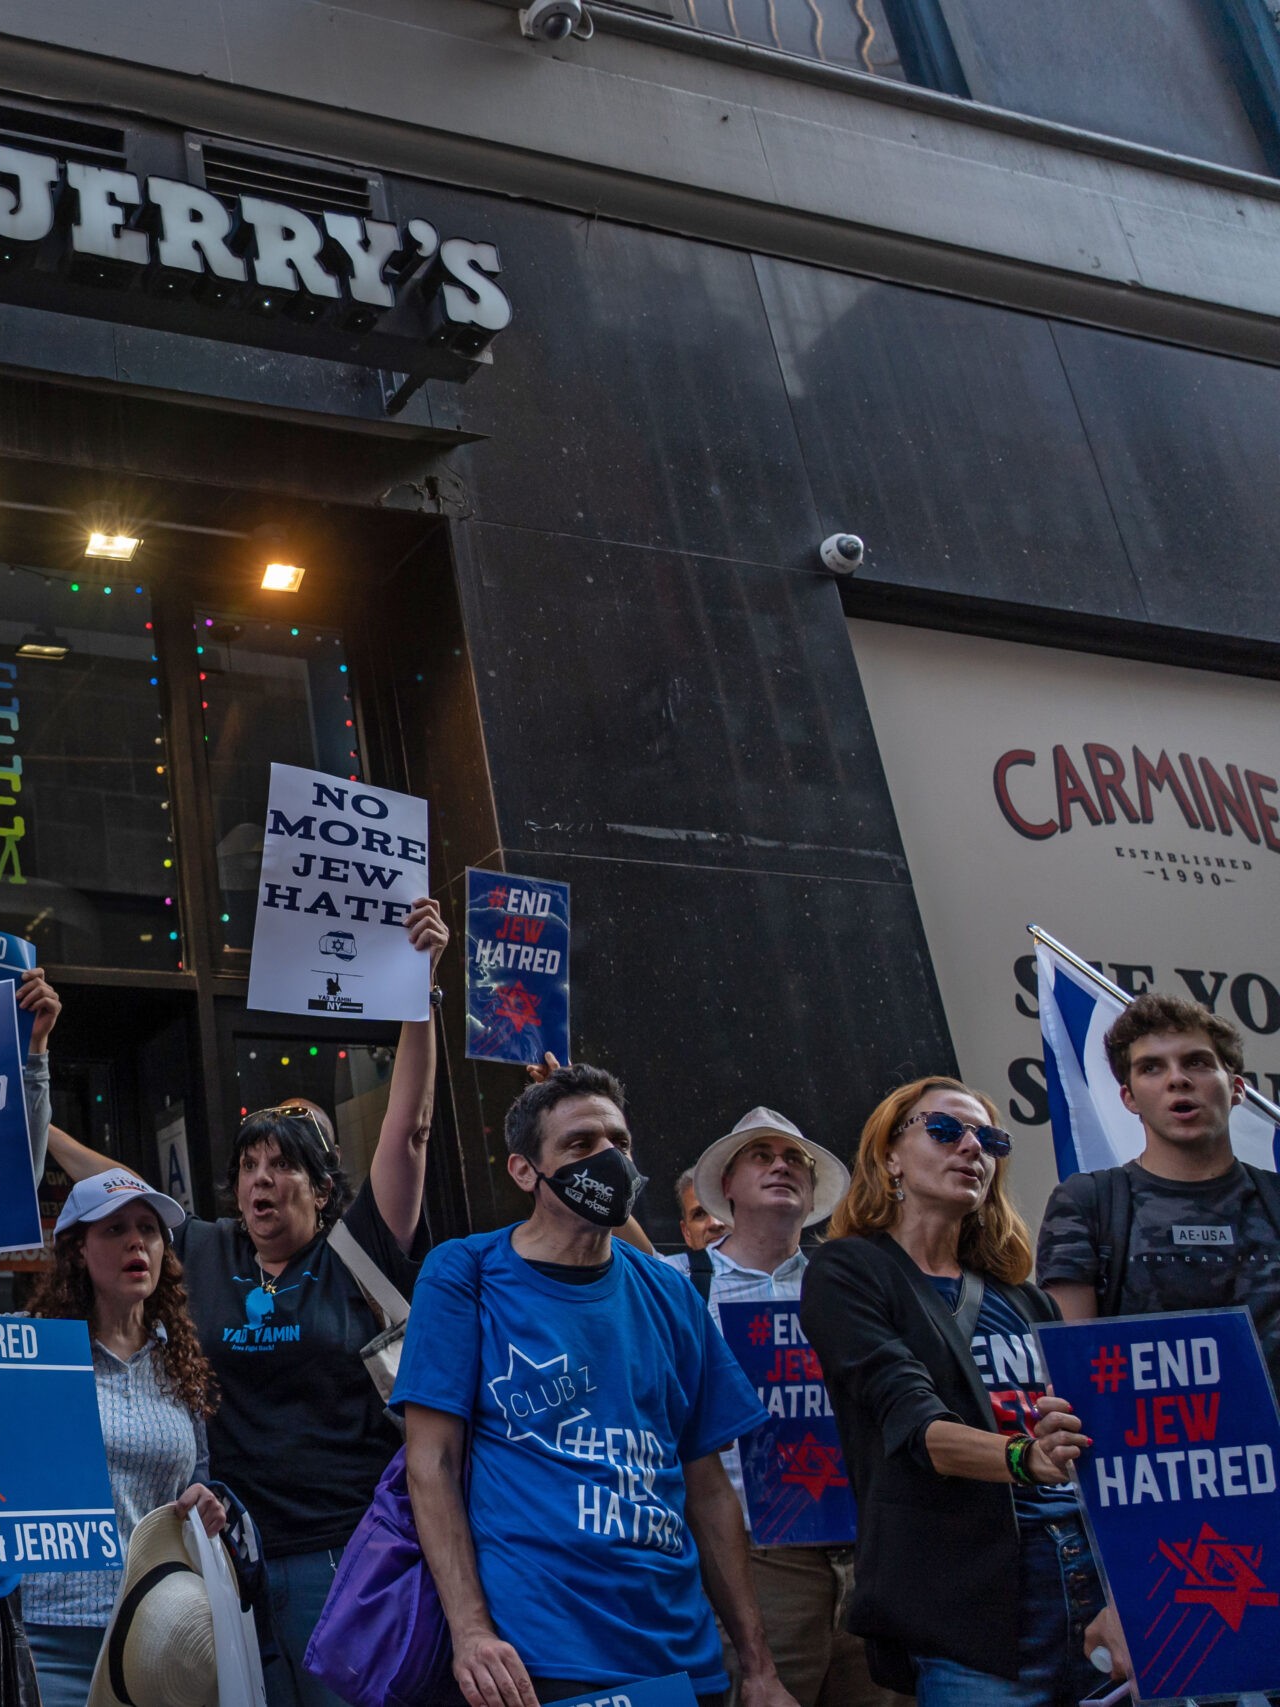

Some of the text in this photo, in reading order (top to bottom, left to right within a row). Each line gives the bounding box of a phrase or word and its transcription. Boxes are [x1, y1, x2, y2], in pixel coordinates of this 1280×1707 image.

[312, 782, 389, 820] NO
[267, 810, 426, 866] MORE
[292, 853, 402, 890] JEW
[1115, 847, 1253, 871] ESTABLISHED
[263, 882, 413, 928] HATE
[487, 886, 552, 916] #END
[496, 916, 545, 943] JEW
[475, 939, 562, 976] HATRED
[327, 1002, 342, 1011] NY
[168, 1143, 186, 1197] A
[221, 1324, 301, 1344] YAD YAMIN
[747, 1312, 809, 1346] #EN
[1090, 1336, 1221, 1394] #END
[510, 1366, 598, 1418] CLUB Z
[1124, 1391, 1220, 1448] JEW
[1095, 1443, 1277, 1507] HATRED
[14, 1520, 118, 1562] JERRY'S
